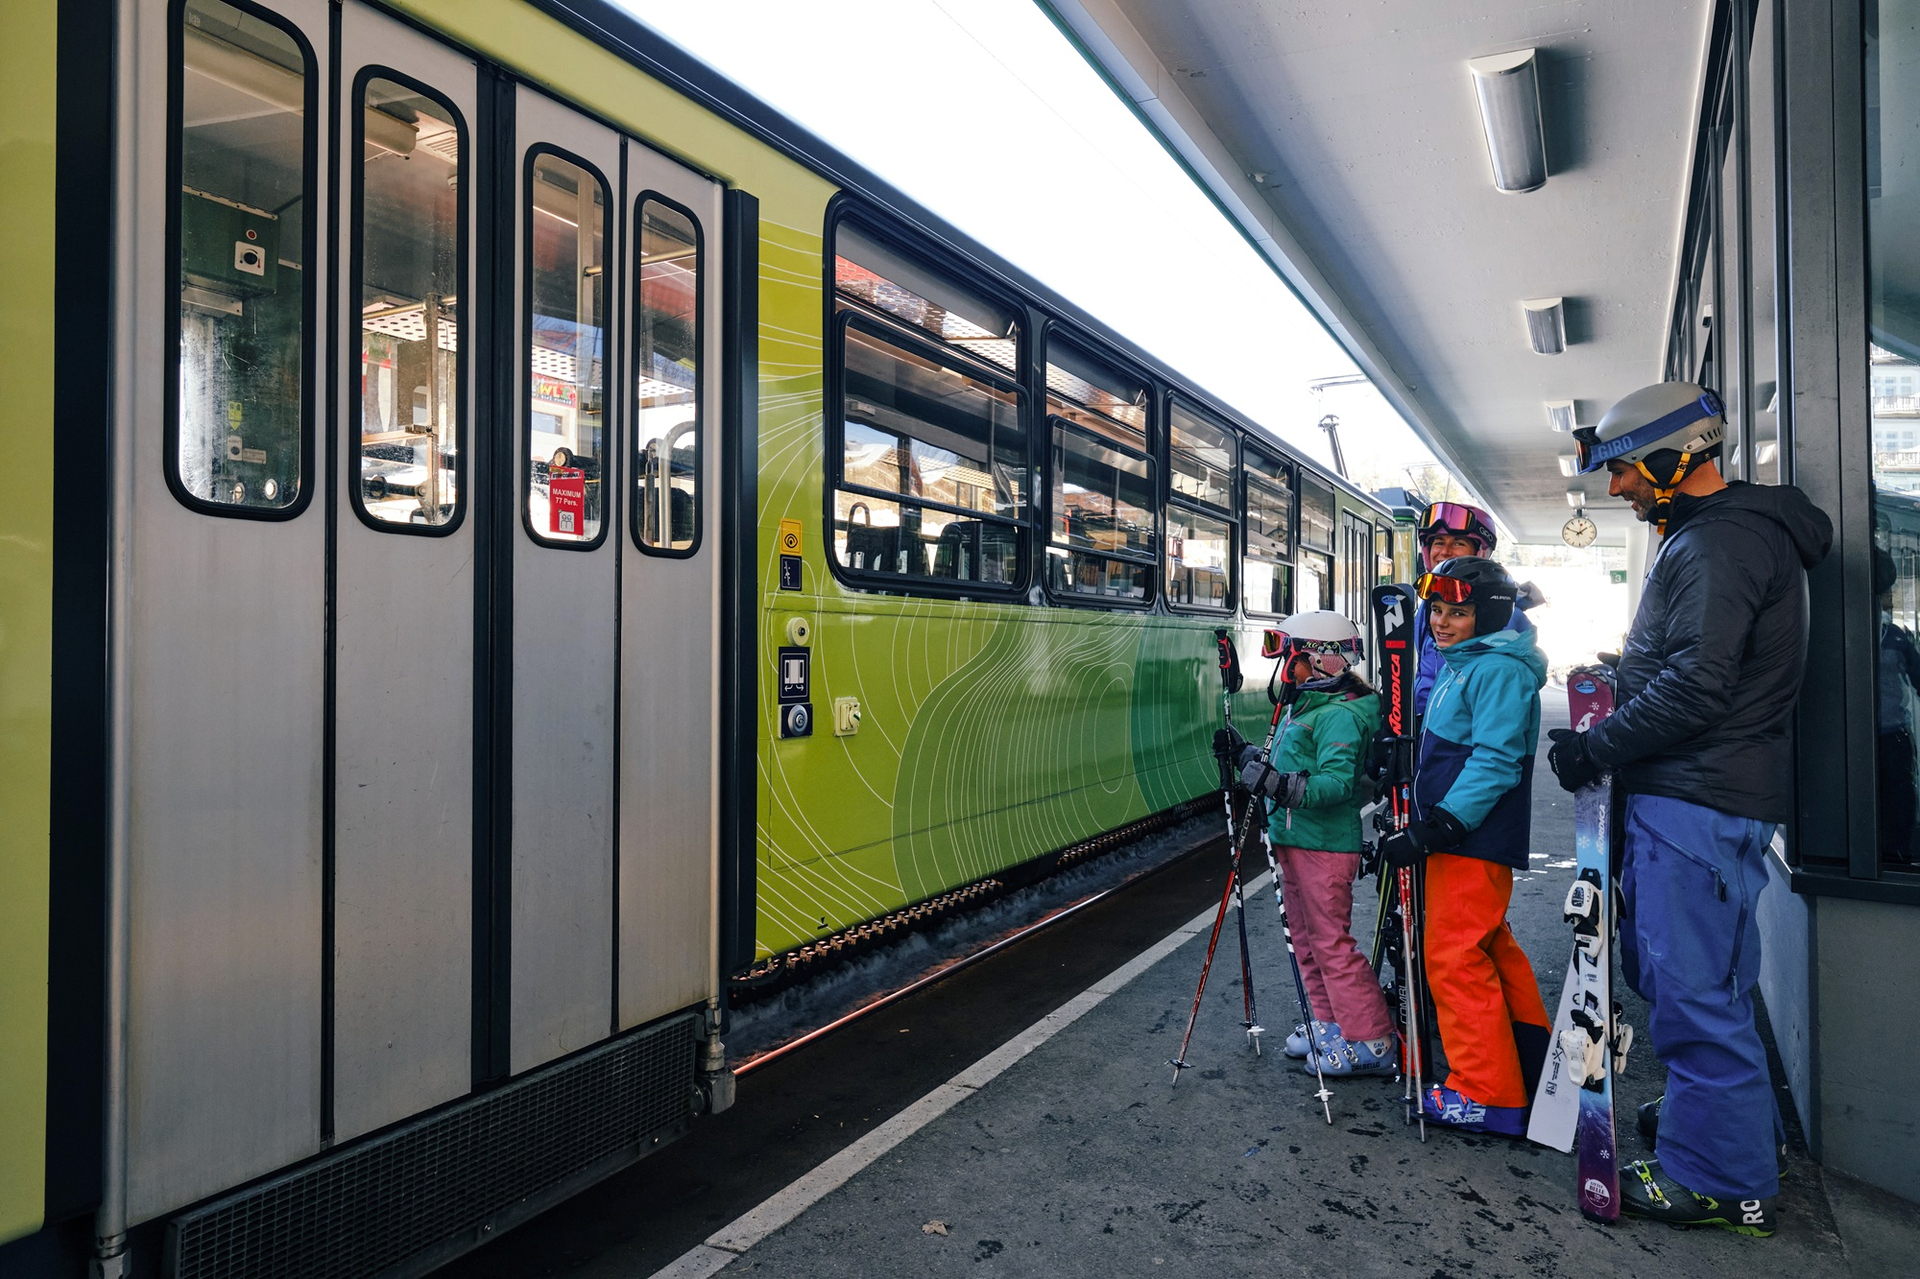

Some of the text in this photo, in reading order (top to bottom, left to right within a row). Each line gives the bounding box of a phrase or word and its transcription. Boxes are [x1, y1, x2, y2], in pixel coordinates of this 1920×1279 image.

[1598, 436, 1633, 459] GIRO
[552, 488, 581, 498] MAXIMUM
[563, 497, 578, 506] Pers.
[1479, 526, 1494, 542] GIRO
[1614, 574, 1622, 582] 3
[1388, 653, 1402, 736] NORDICA
[1595, 804, 1606, 856] NORDICA
[1351, 1061, 1381, 1072] DALBELLO
[1450, 1116, 1485, 1124] LANGE
